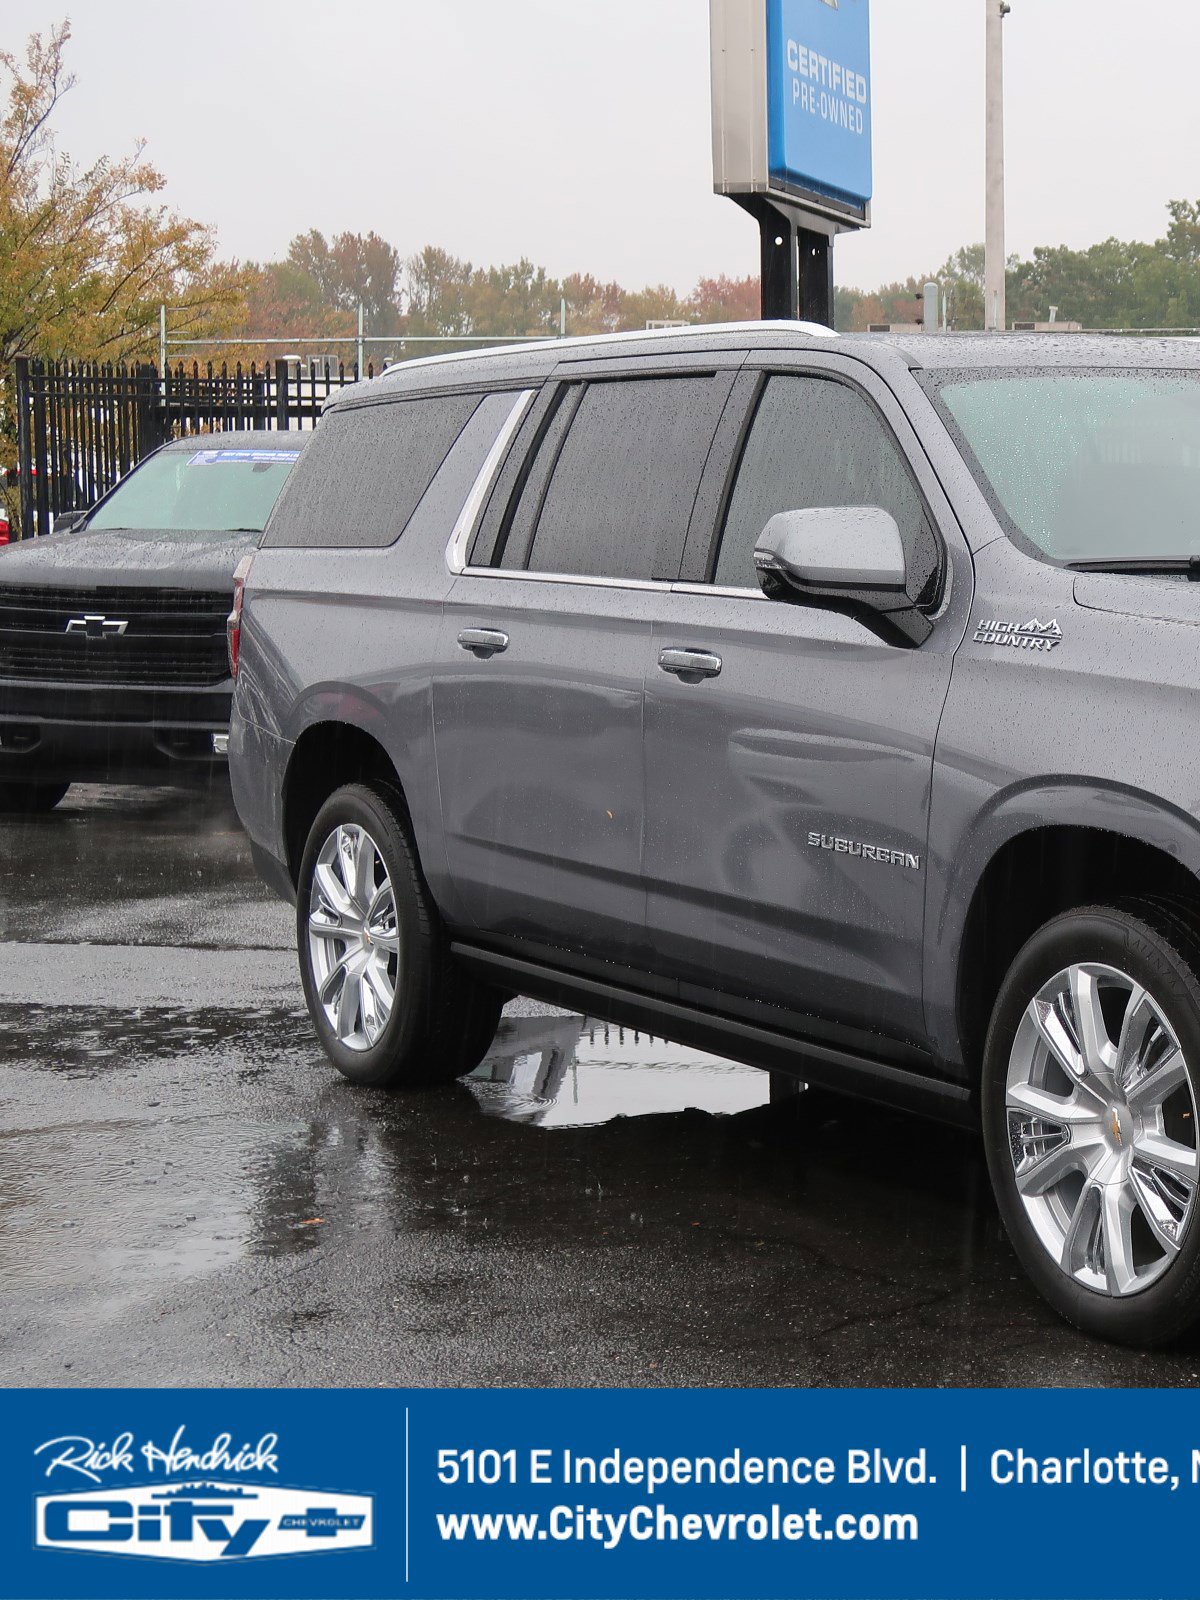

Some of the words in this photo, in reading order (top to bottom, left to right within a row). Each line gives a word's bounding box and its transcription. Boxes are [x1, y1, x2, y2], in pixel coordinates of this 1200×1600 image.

[787, 38, 867, 104] CERTIFIED
[792, 77, 863, 135] PRE-OWNED
[973, 631, 1060, 652] COUNTRY
[977, 619, 1021, 634] HIGH
[807, 831, 920, 870] SUBURBAN
